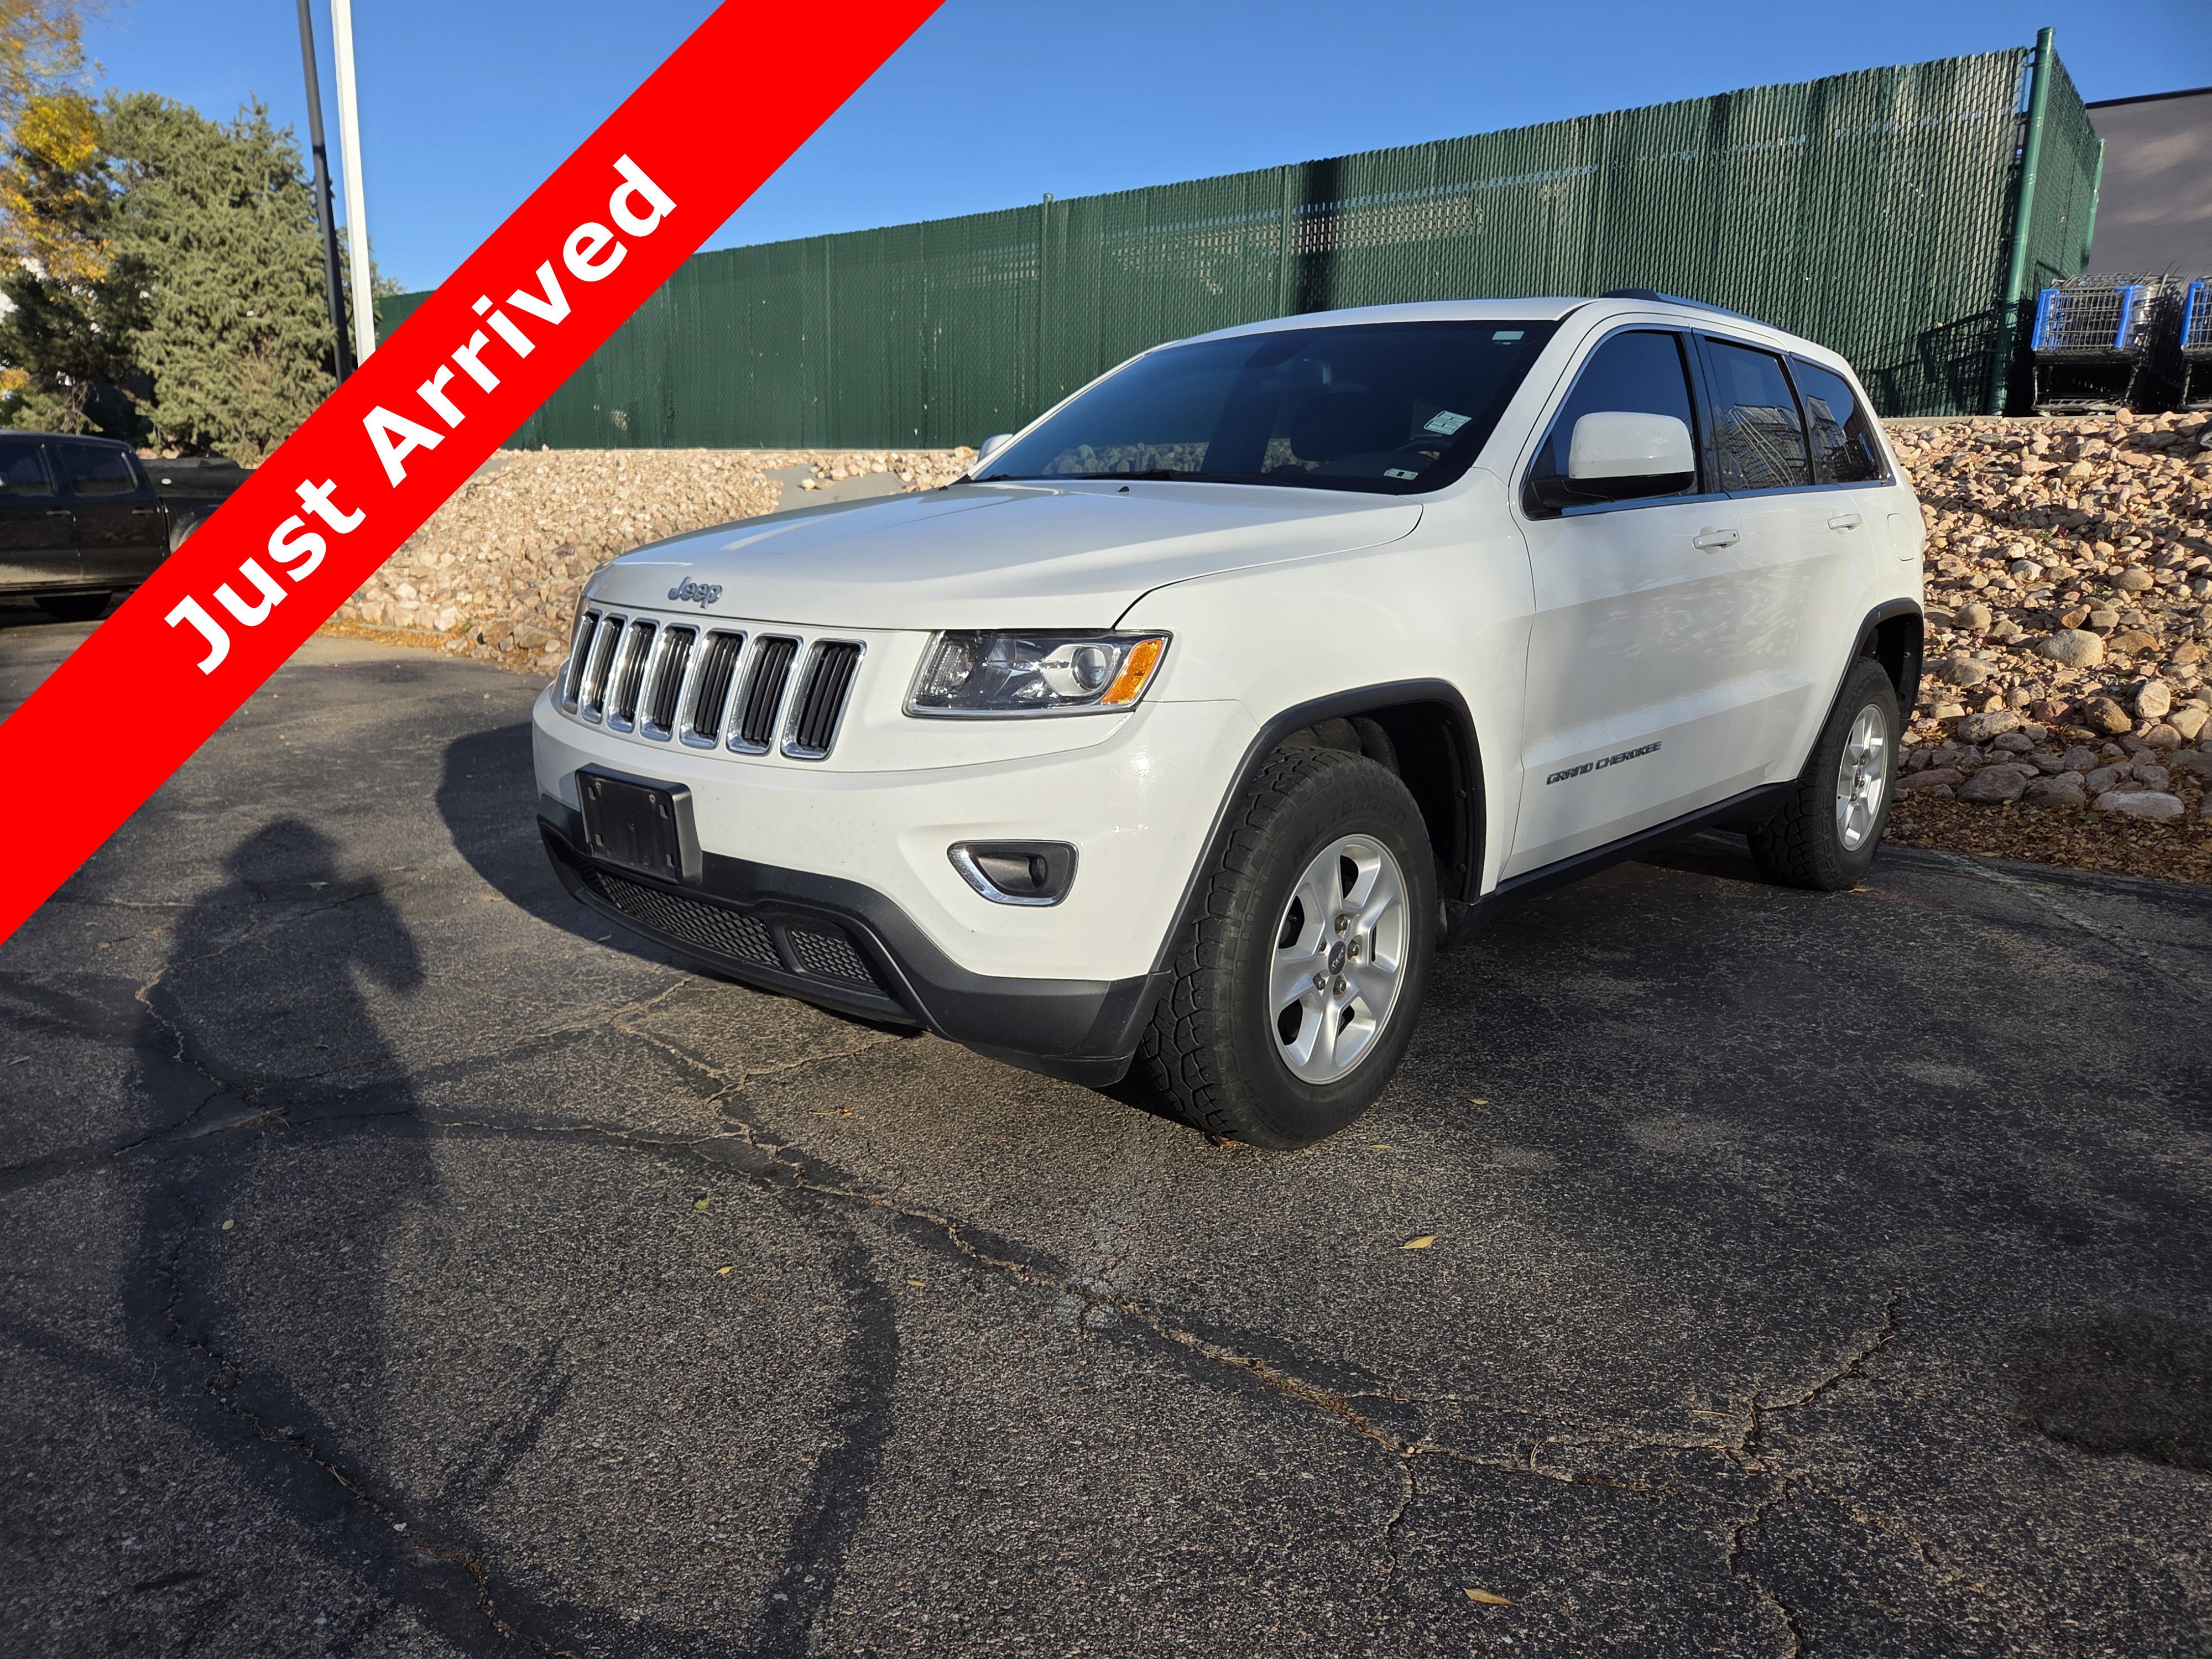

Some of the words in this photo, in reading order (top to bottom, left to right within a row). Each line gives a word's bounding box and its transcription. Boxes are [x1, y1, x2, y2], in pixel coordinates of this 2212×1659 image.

[667, 576, 723, 609] Jeep
[1546, 762, 1594, 785] GRAND
[1595, 740, 1662, 770] CHEROKEE
